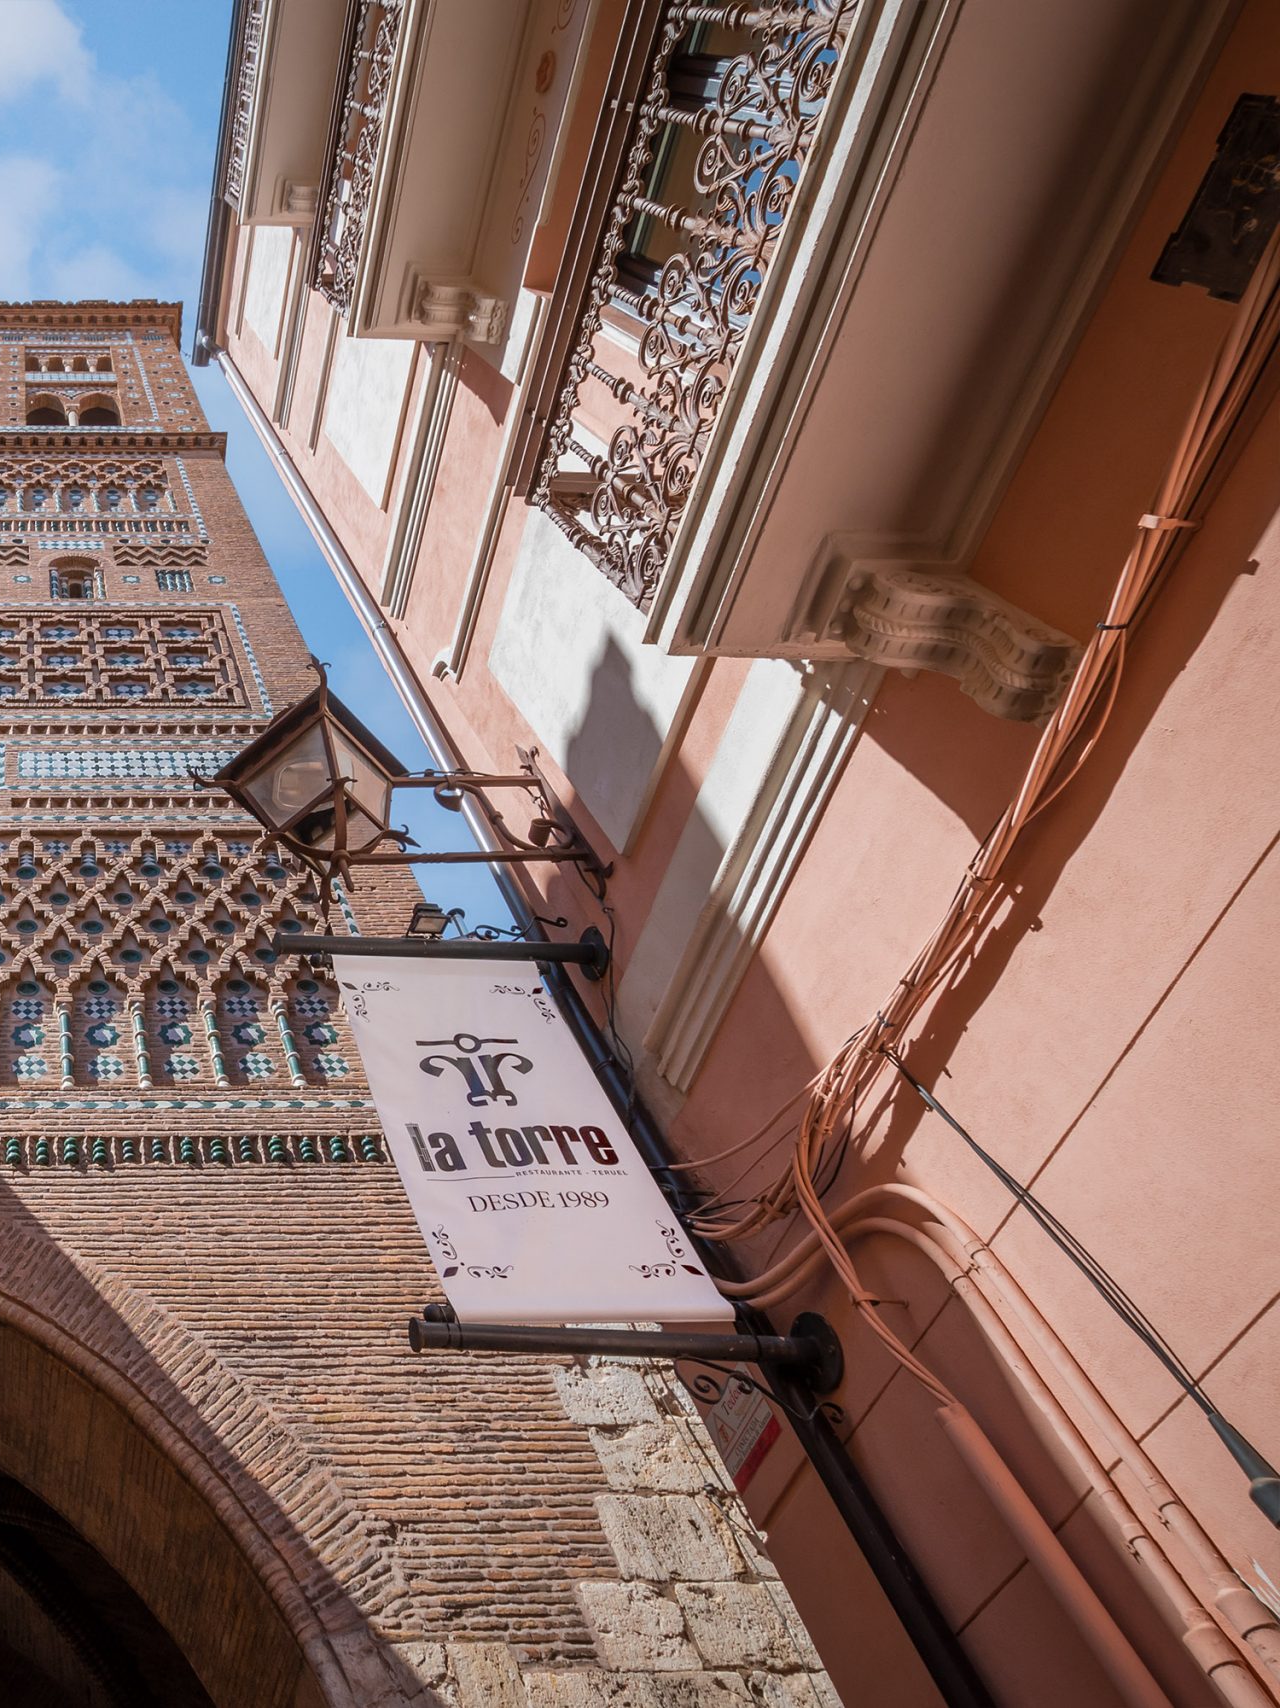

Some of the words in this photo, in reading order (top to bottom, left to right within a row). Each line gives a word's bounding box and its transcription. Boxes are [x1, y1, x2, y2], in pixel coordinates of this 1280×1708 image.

[404, 1122, 468, 1173] la
[467, 1120, 620, 1169] torre
[515, 1168, 583, 1178] RESTAURANTE
[591, 1168, 629, 1177] TERUEL
[466, 1190, 555, 1213] DESDE
[557, 1190, 610, 1209] 1989
